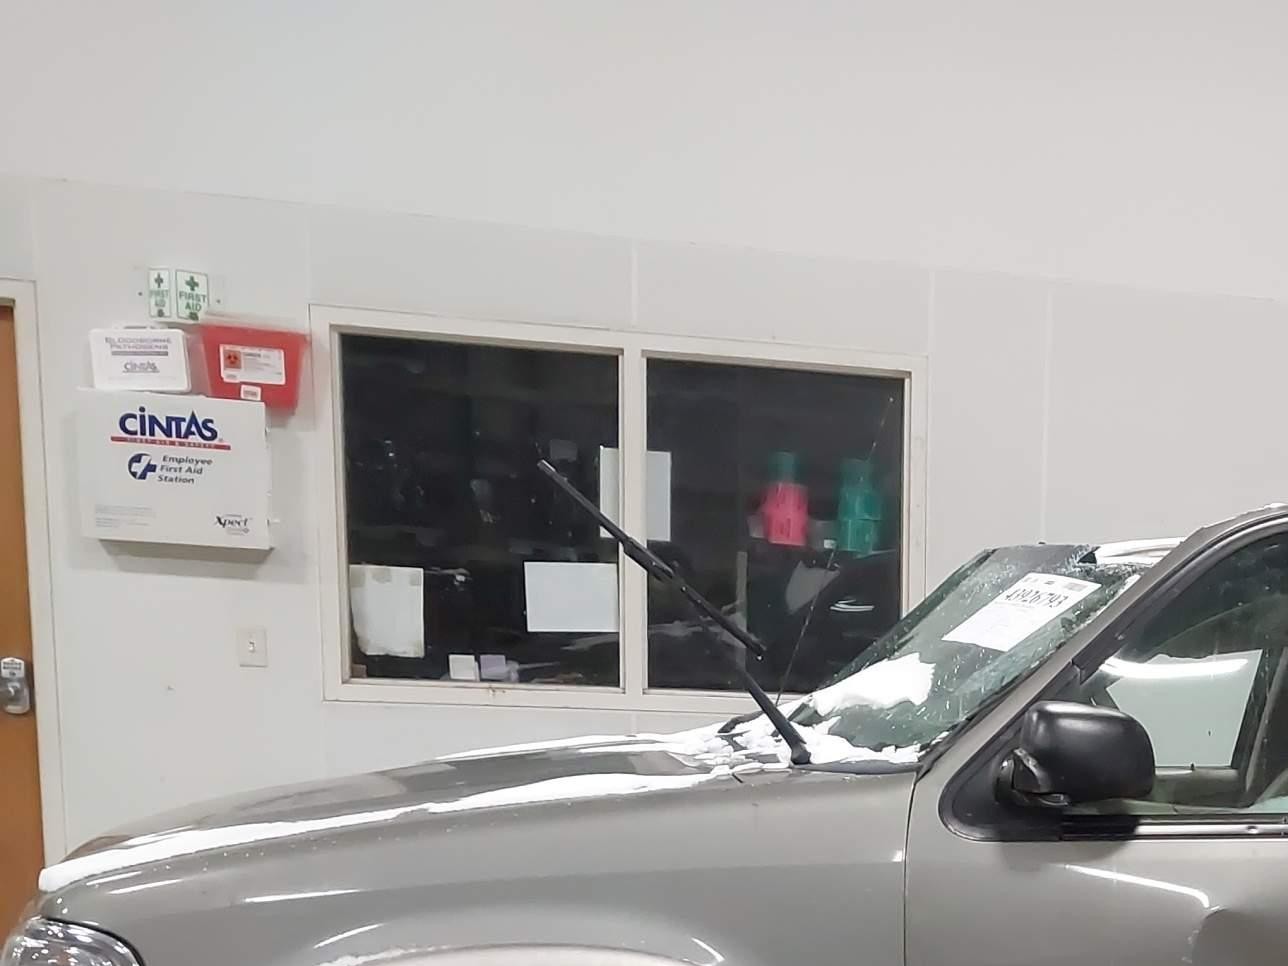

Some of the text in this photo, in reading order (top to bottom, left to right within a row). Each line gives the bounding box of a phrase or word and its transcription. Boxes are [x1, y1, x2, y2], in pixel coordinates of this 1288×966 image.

[179, 290, 206, 303] FIRST
[185, 301, 202, 312] AID
[162, 455, 213, 466] Employee
[160, 464, 203, 475] First Aid
[158, 474, 195, 484] Station
